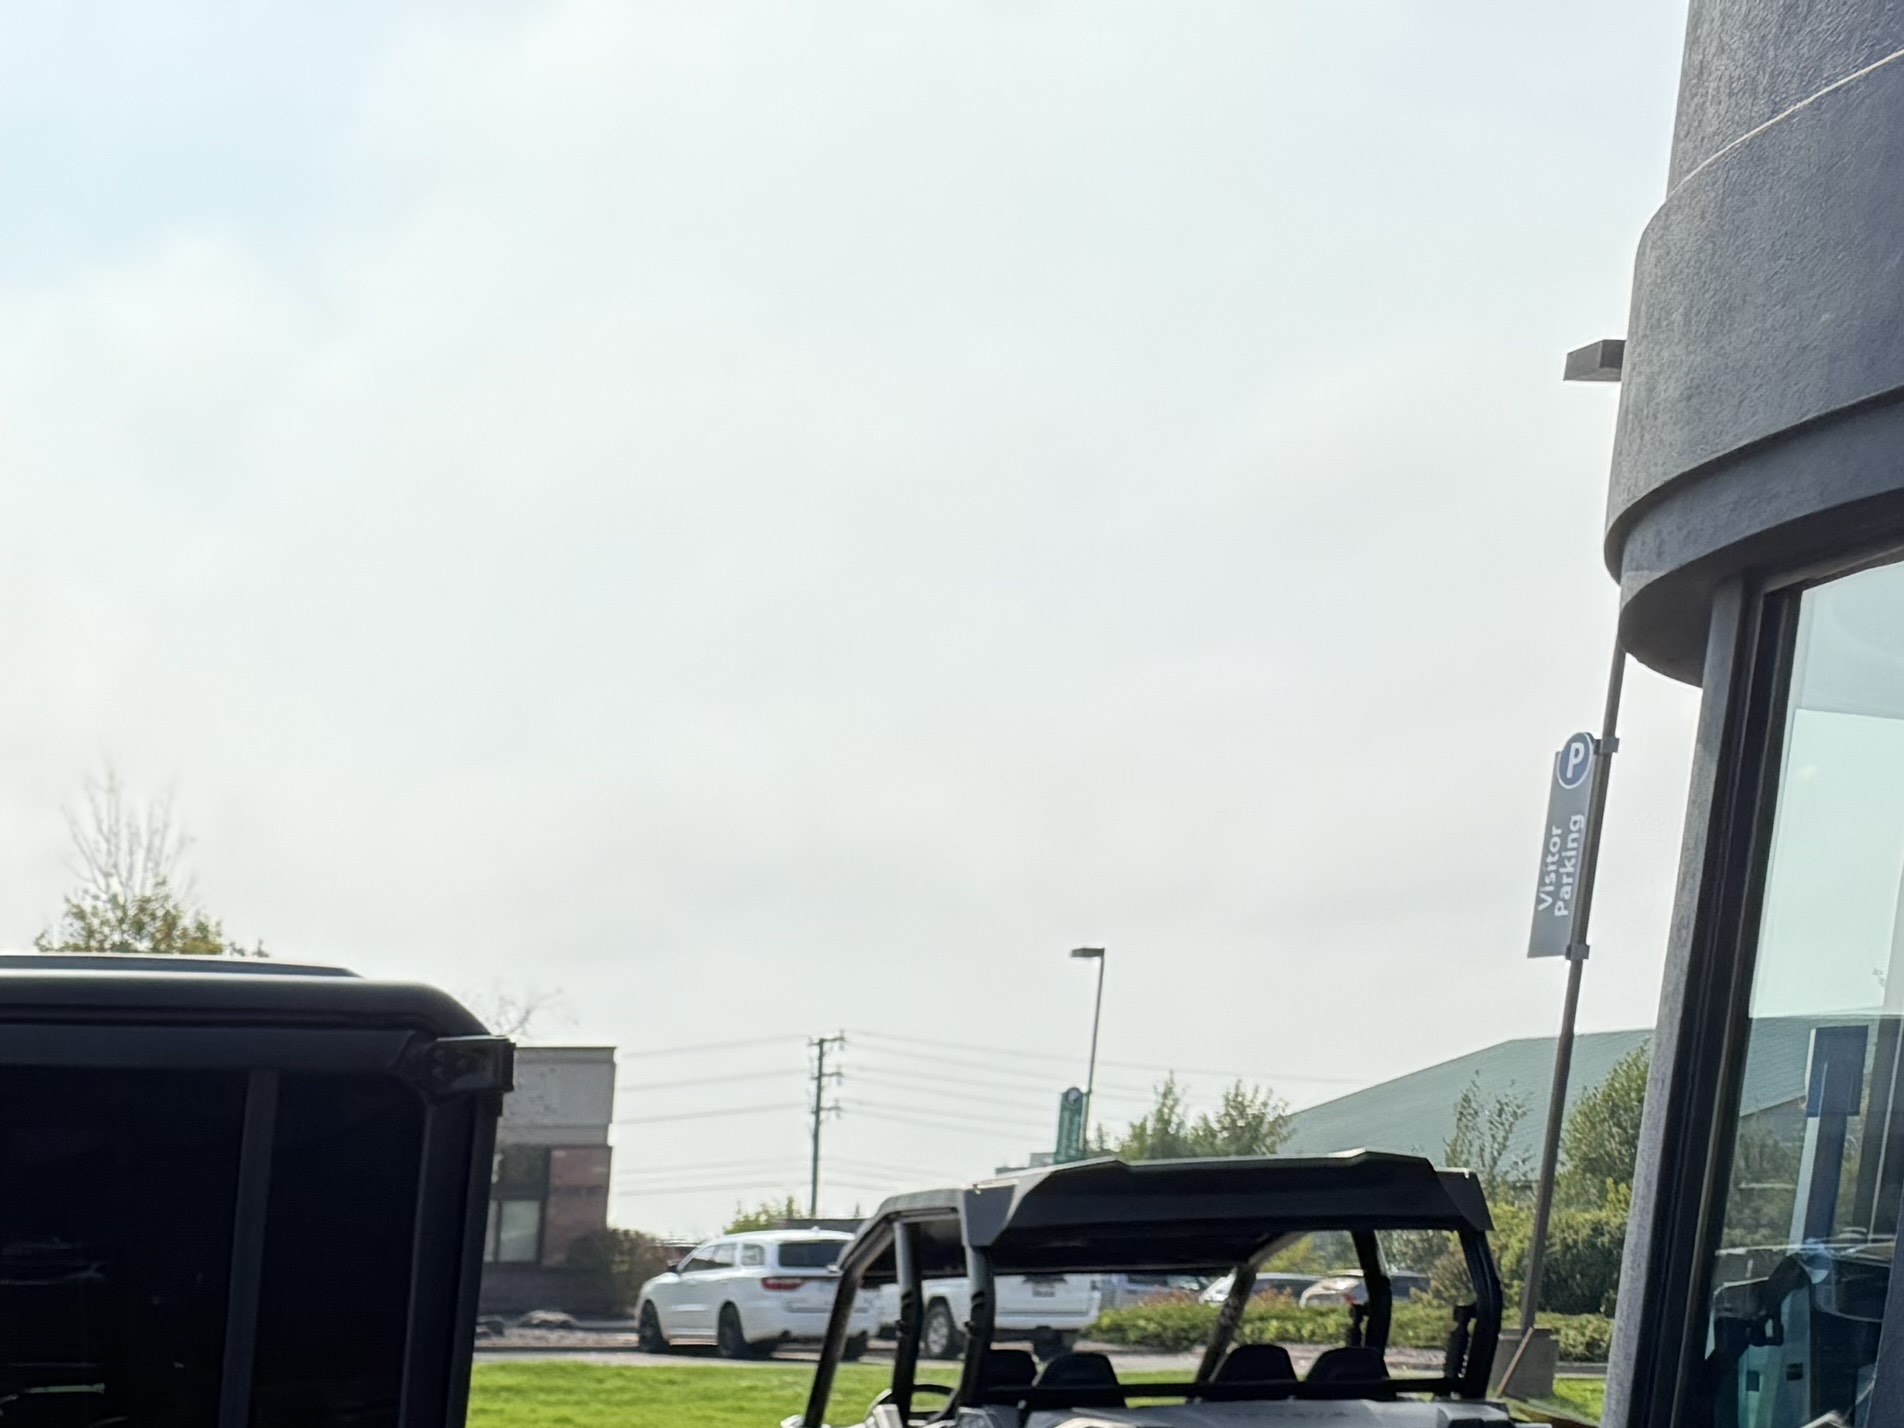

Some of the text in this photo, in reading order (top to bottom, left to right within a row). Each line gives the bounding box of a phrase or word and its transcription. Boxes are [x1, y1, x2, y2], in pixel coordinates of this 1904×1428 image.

[1566, 741, 1585, 779] P
[1537, 825, 1563, 911] Visitor
[1553, 814, 1585, 917] Parking
